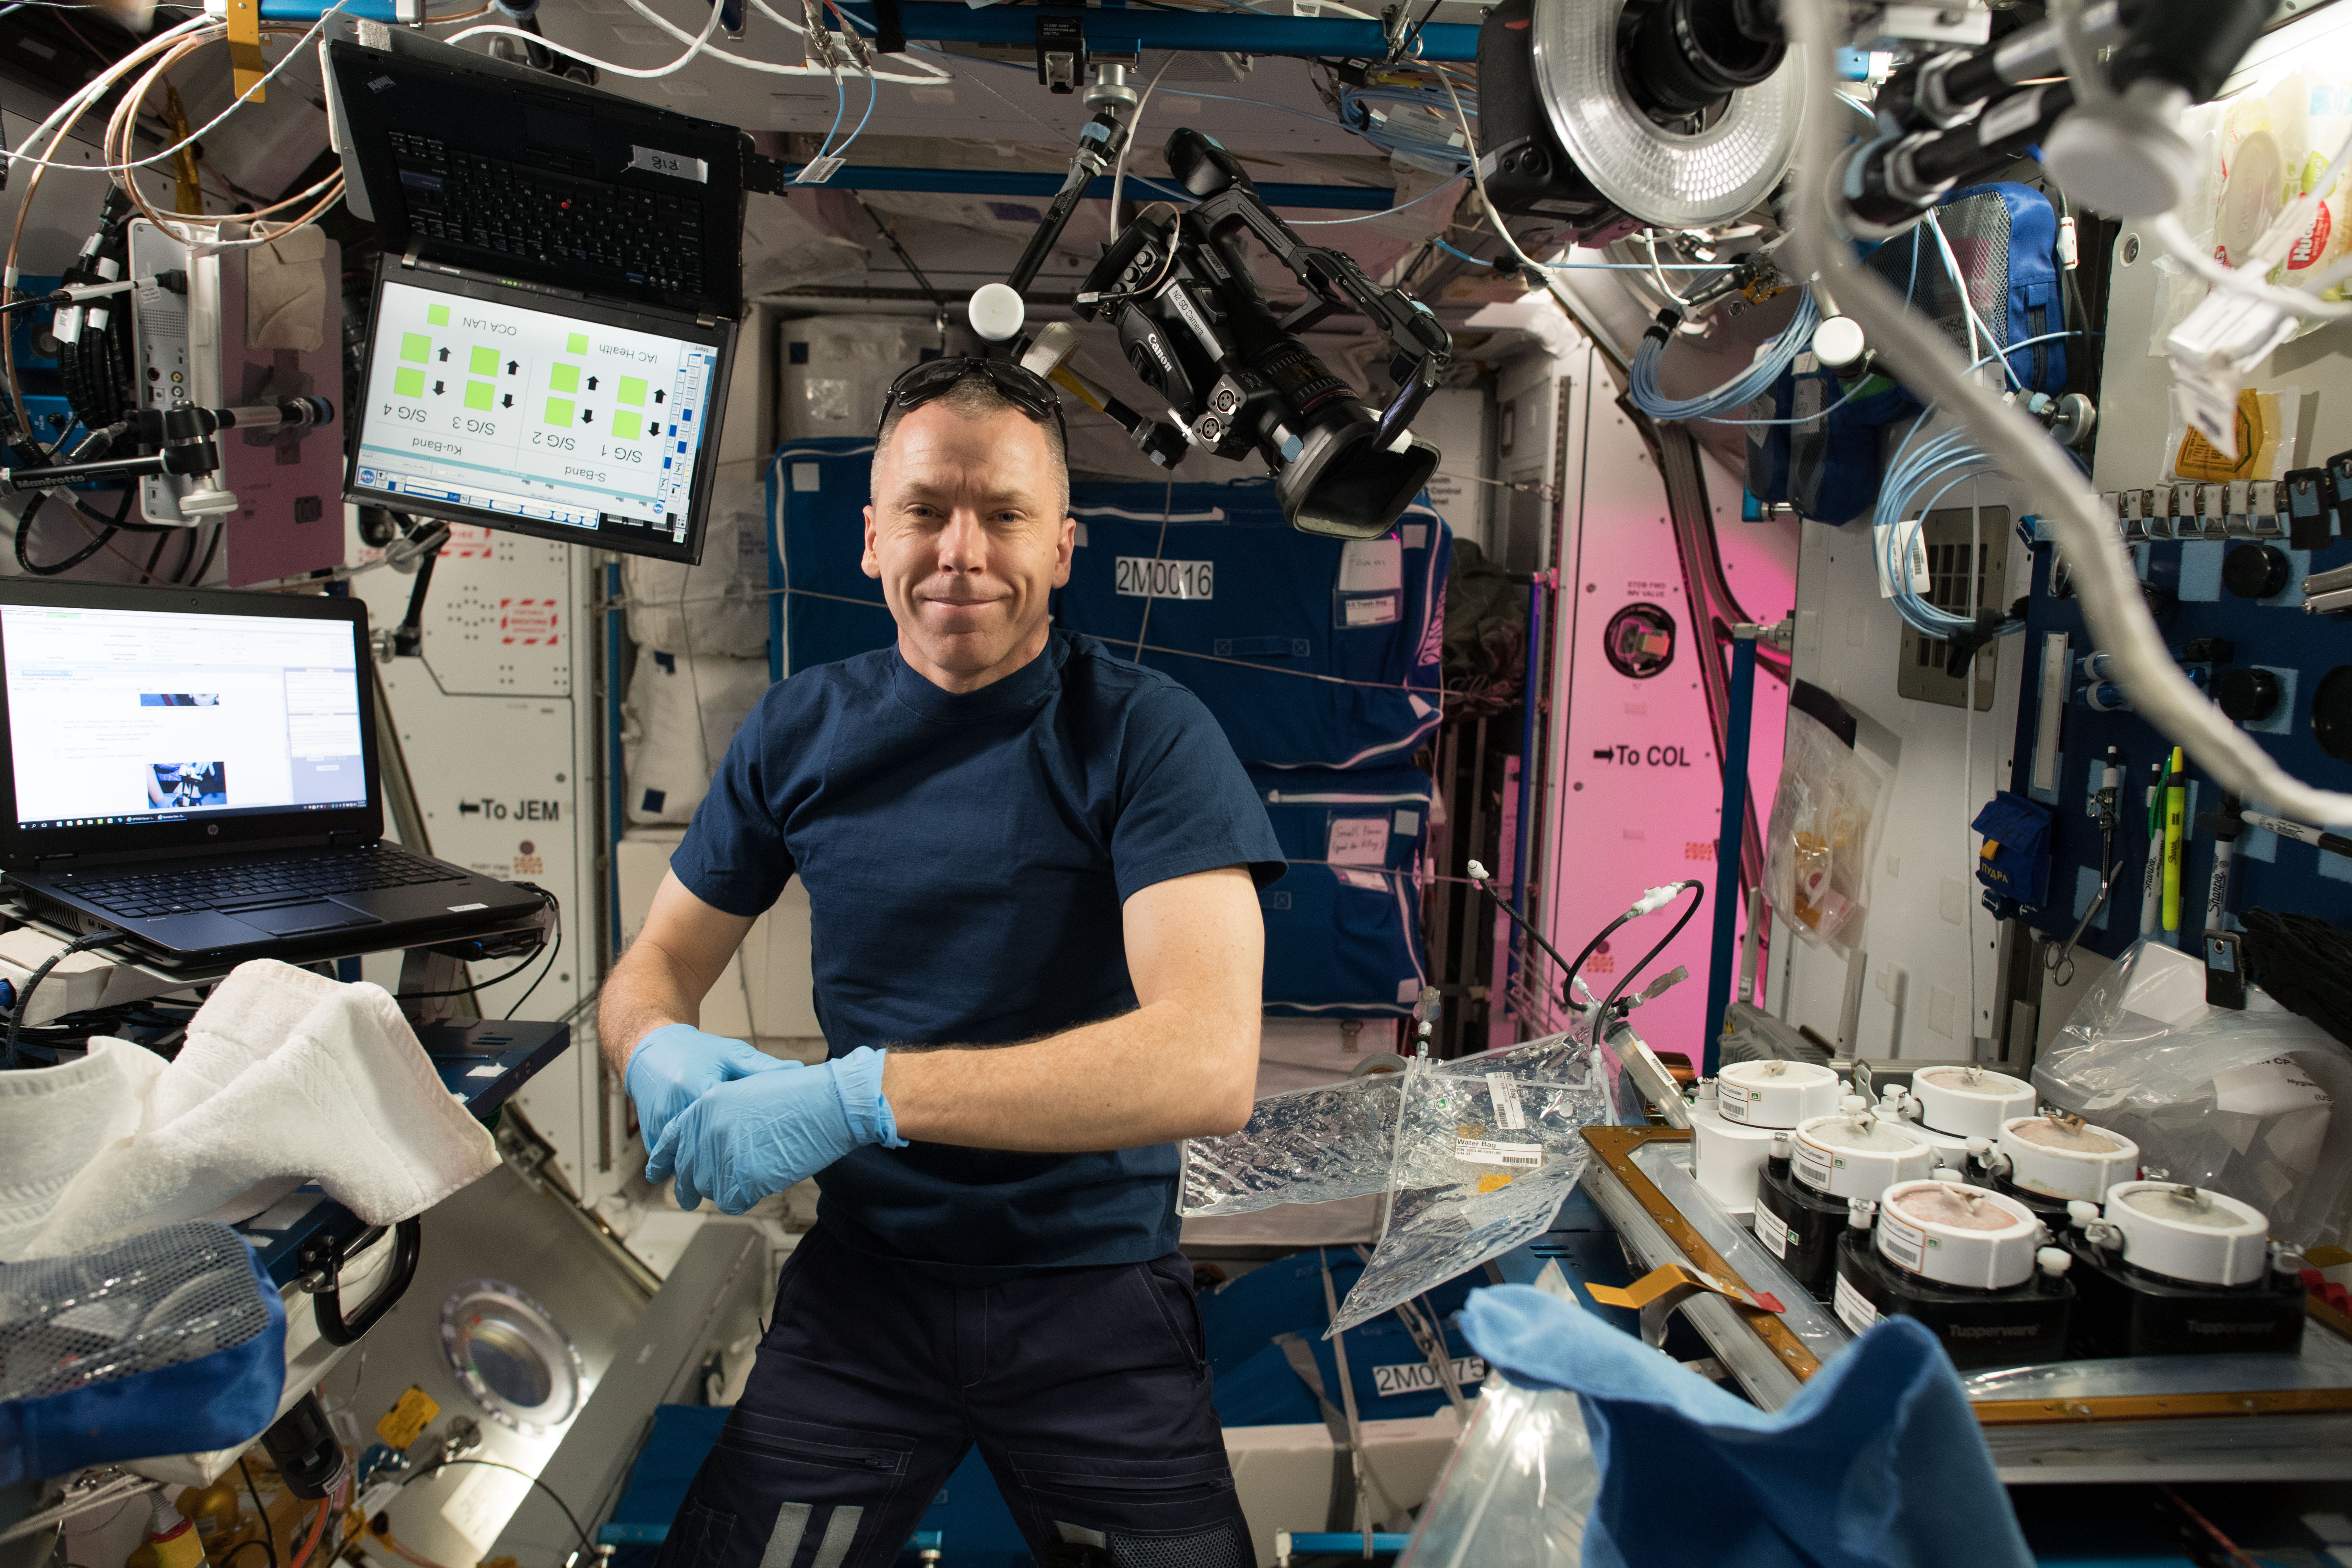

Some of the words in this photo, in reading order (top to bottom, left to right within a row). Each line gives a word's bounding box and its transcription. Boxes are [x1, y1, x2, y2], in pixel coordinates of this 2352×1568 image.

[1204, 248, 1227, 275] AUG2017
[1172, 289, 1183, 302] N2
[1178, 298, 1188, 310] SD
[1185, 309, 1205, 337] Camera
[463, 318, 486, 331] LAN
[491, 322, 517, 336] OCA
[599, 344, 634, 359] Health
[695, 346, 709, 354] Start
[1148, 333, 1173, 373] Canon
[638, 352, 658, 364] IAC
[383, 403, 392, 416] 4
[398, 407, 427, 422] S/G
[452, 417, 461, 429] 3
[467, 420, 496, 436] S/G
[532, 432, 542, 444] 2
[547, 435, 576, 450] S/G
[413, 438, 462, 455] Ku-Band
[602, 445, 607, 457] 1
[615, 448, 642, 463] S/G
[16, 475, 86, 488] Manfrotto
[565, 466, 607, 482] S-Band
[1117, 558, 1212, 598] 2M0016
[1615, 745, 1640, 766] To
[1647, 746, 1690, 767] COL
[481, 799, 507, 820] To
[514, 800, 559, 820] JEM
[2167, 838, 2178, 866] Sharpie
[1981, 862, 2009, 884] ПУДРА
[2143, 855, 2157, 897] Sharpie
[2208, 871, 2225, 917] Sharpie
[1726, 1087, 1742, 1096] Cylinder
[1457, 1138, 1480, 1147] Water
[1481, 1141, 1497, 1149] Bag
[1804, 1149, 1825, 1161] Cylinder
[1949, 1323, 2039, 1338] Tupperware
[2186, 1320, 2276, 1335] Tupperware
